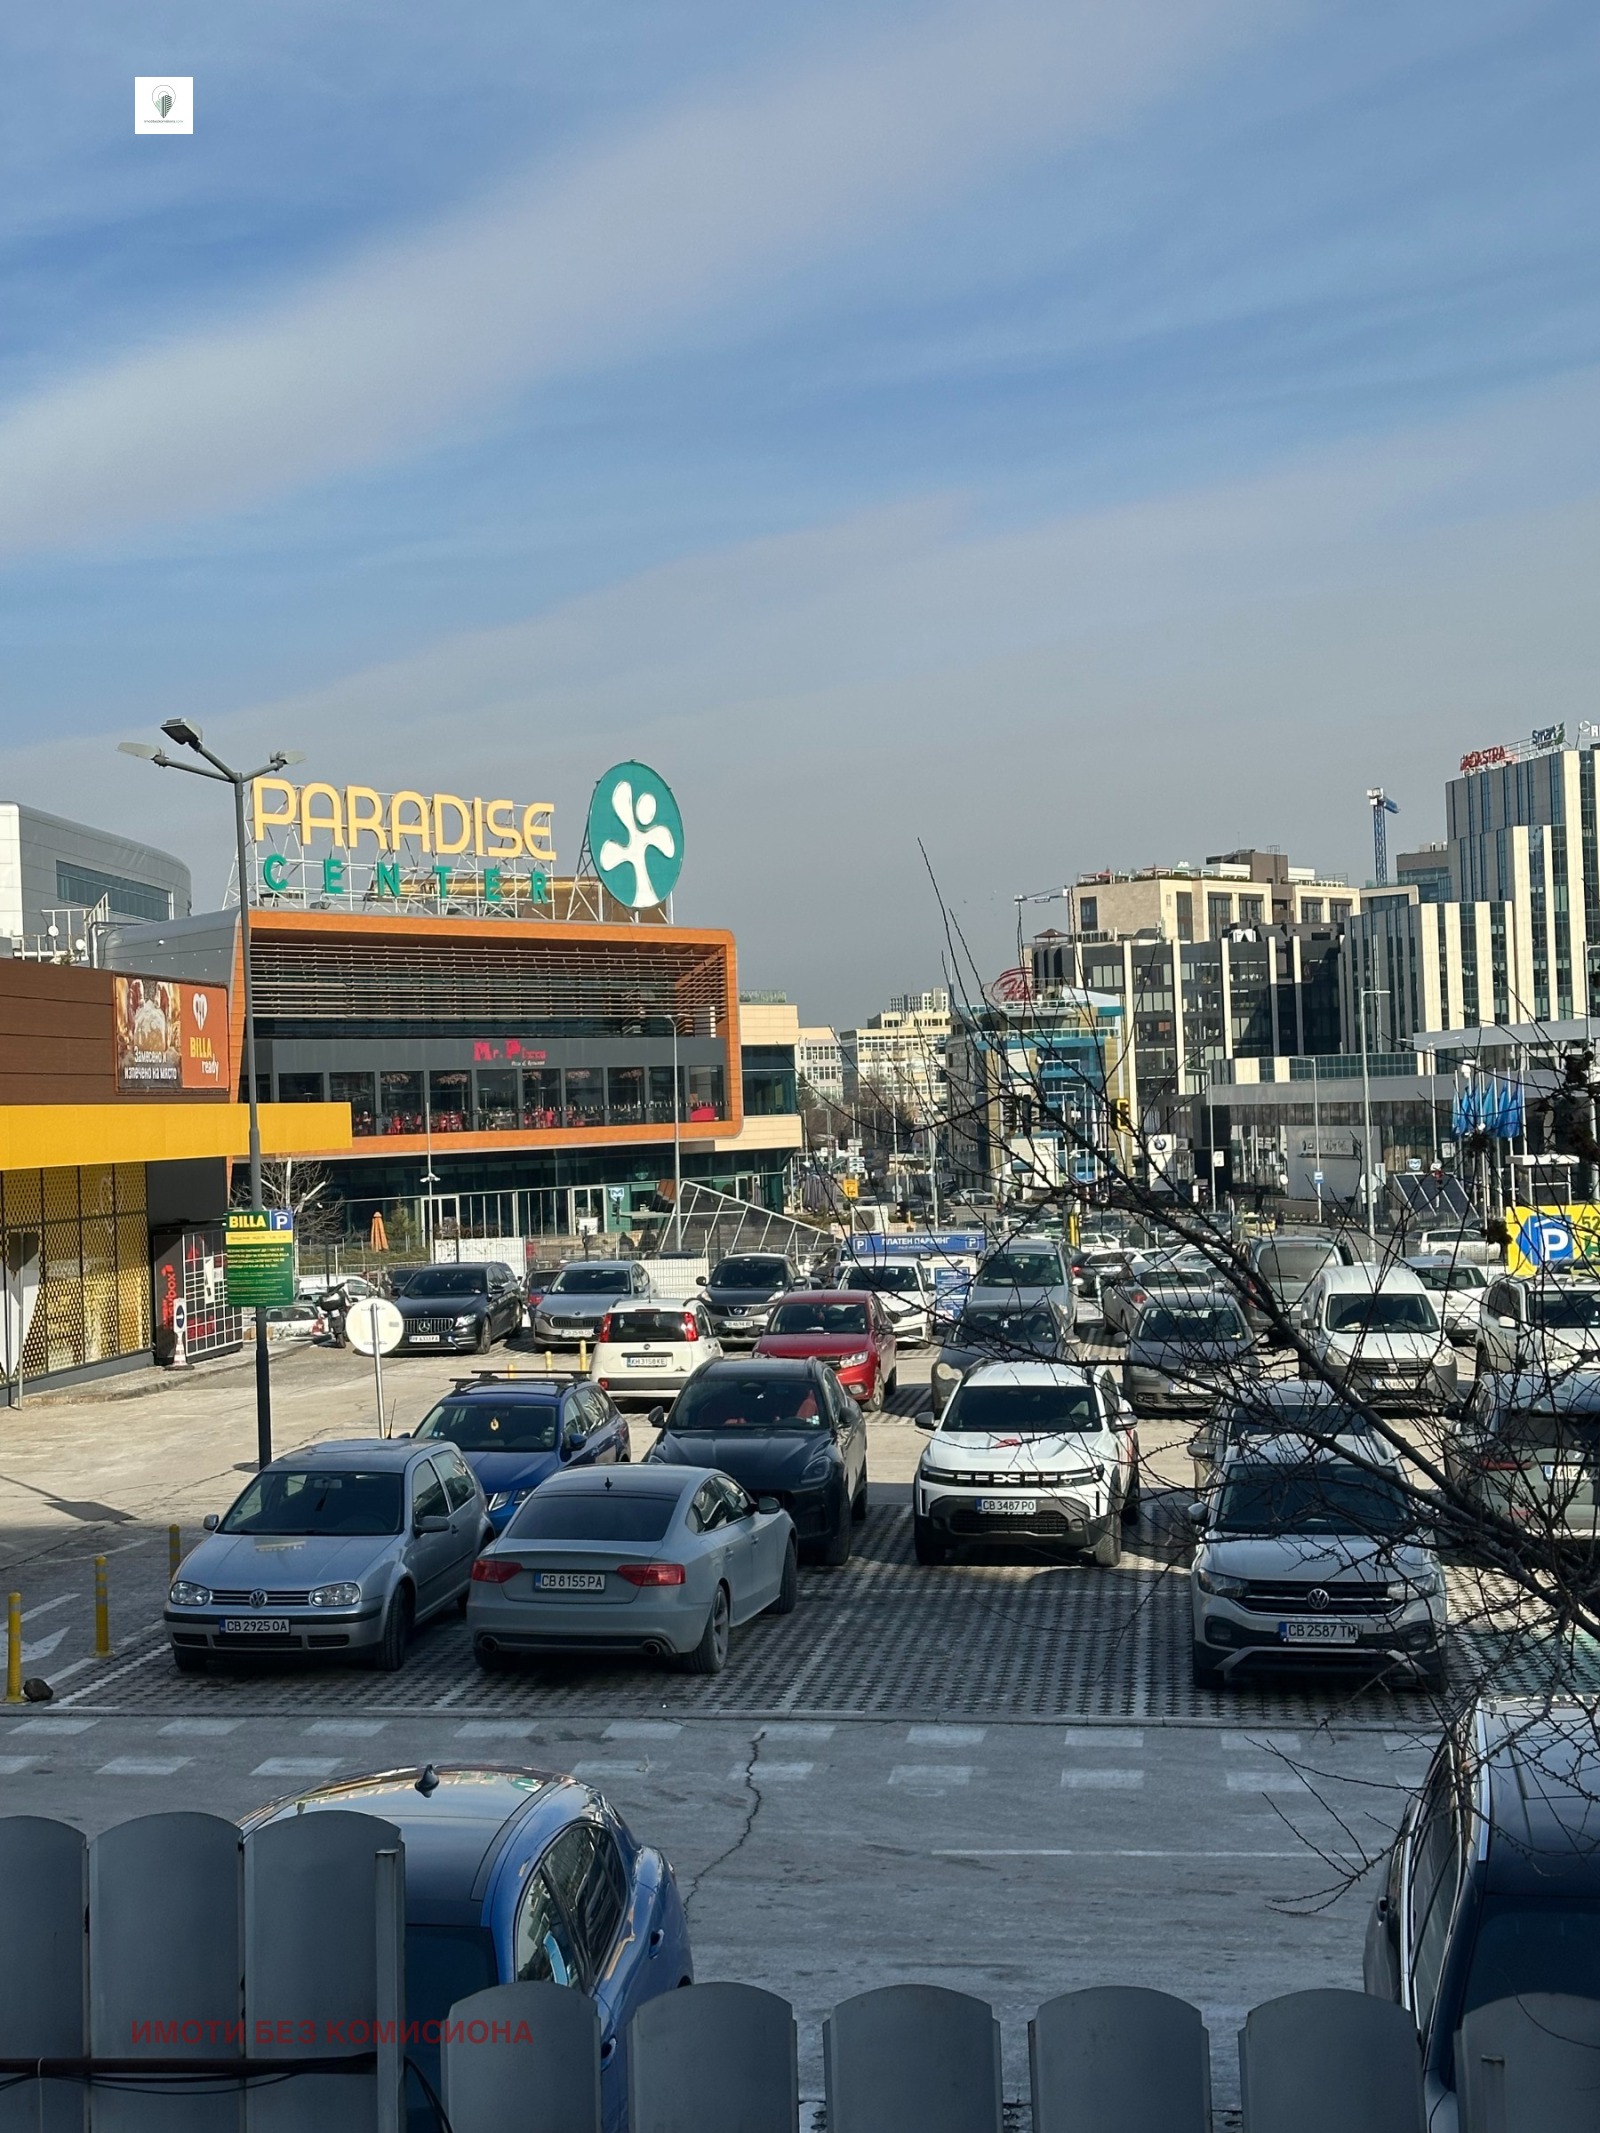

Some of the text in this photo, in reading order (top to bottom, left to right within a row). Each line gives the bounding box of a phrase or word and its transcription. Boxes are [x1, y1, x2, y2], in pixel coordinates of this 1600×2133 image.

[252, 777, 557, 861] PARADISE
[263, 853, 548, 904] CENTER
[190, 1037, 212, 1058] BILLA
[202, 1053, 219, 1081] ready
[229, 1215, 288, 1230] BILLA P
[1541, 1228, 1569, 1262] P
[982, 1500, 995, 1510] CB
[997, 1500, 1020, 1511] 3487
[541, 1575, 602, 1588] CB 8155 PA
[227, 1621, 287, 1632] CB 2925 OA
[1288, 1624, 1305, 1637] CB
[1307, 1624, 1337, 1637] 2587
